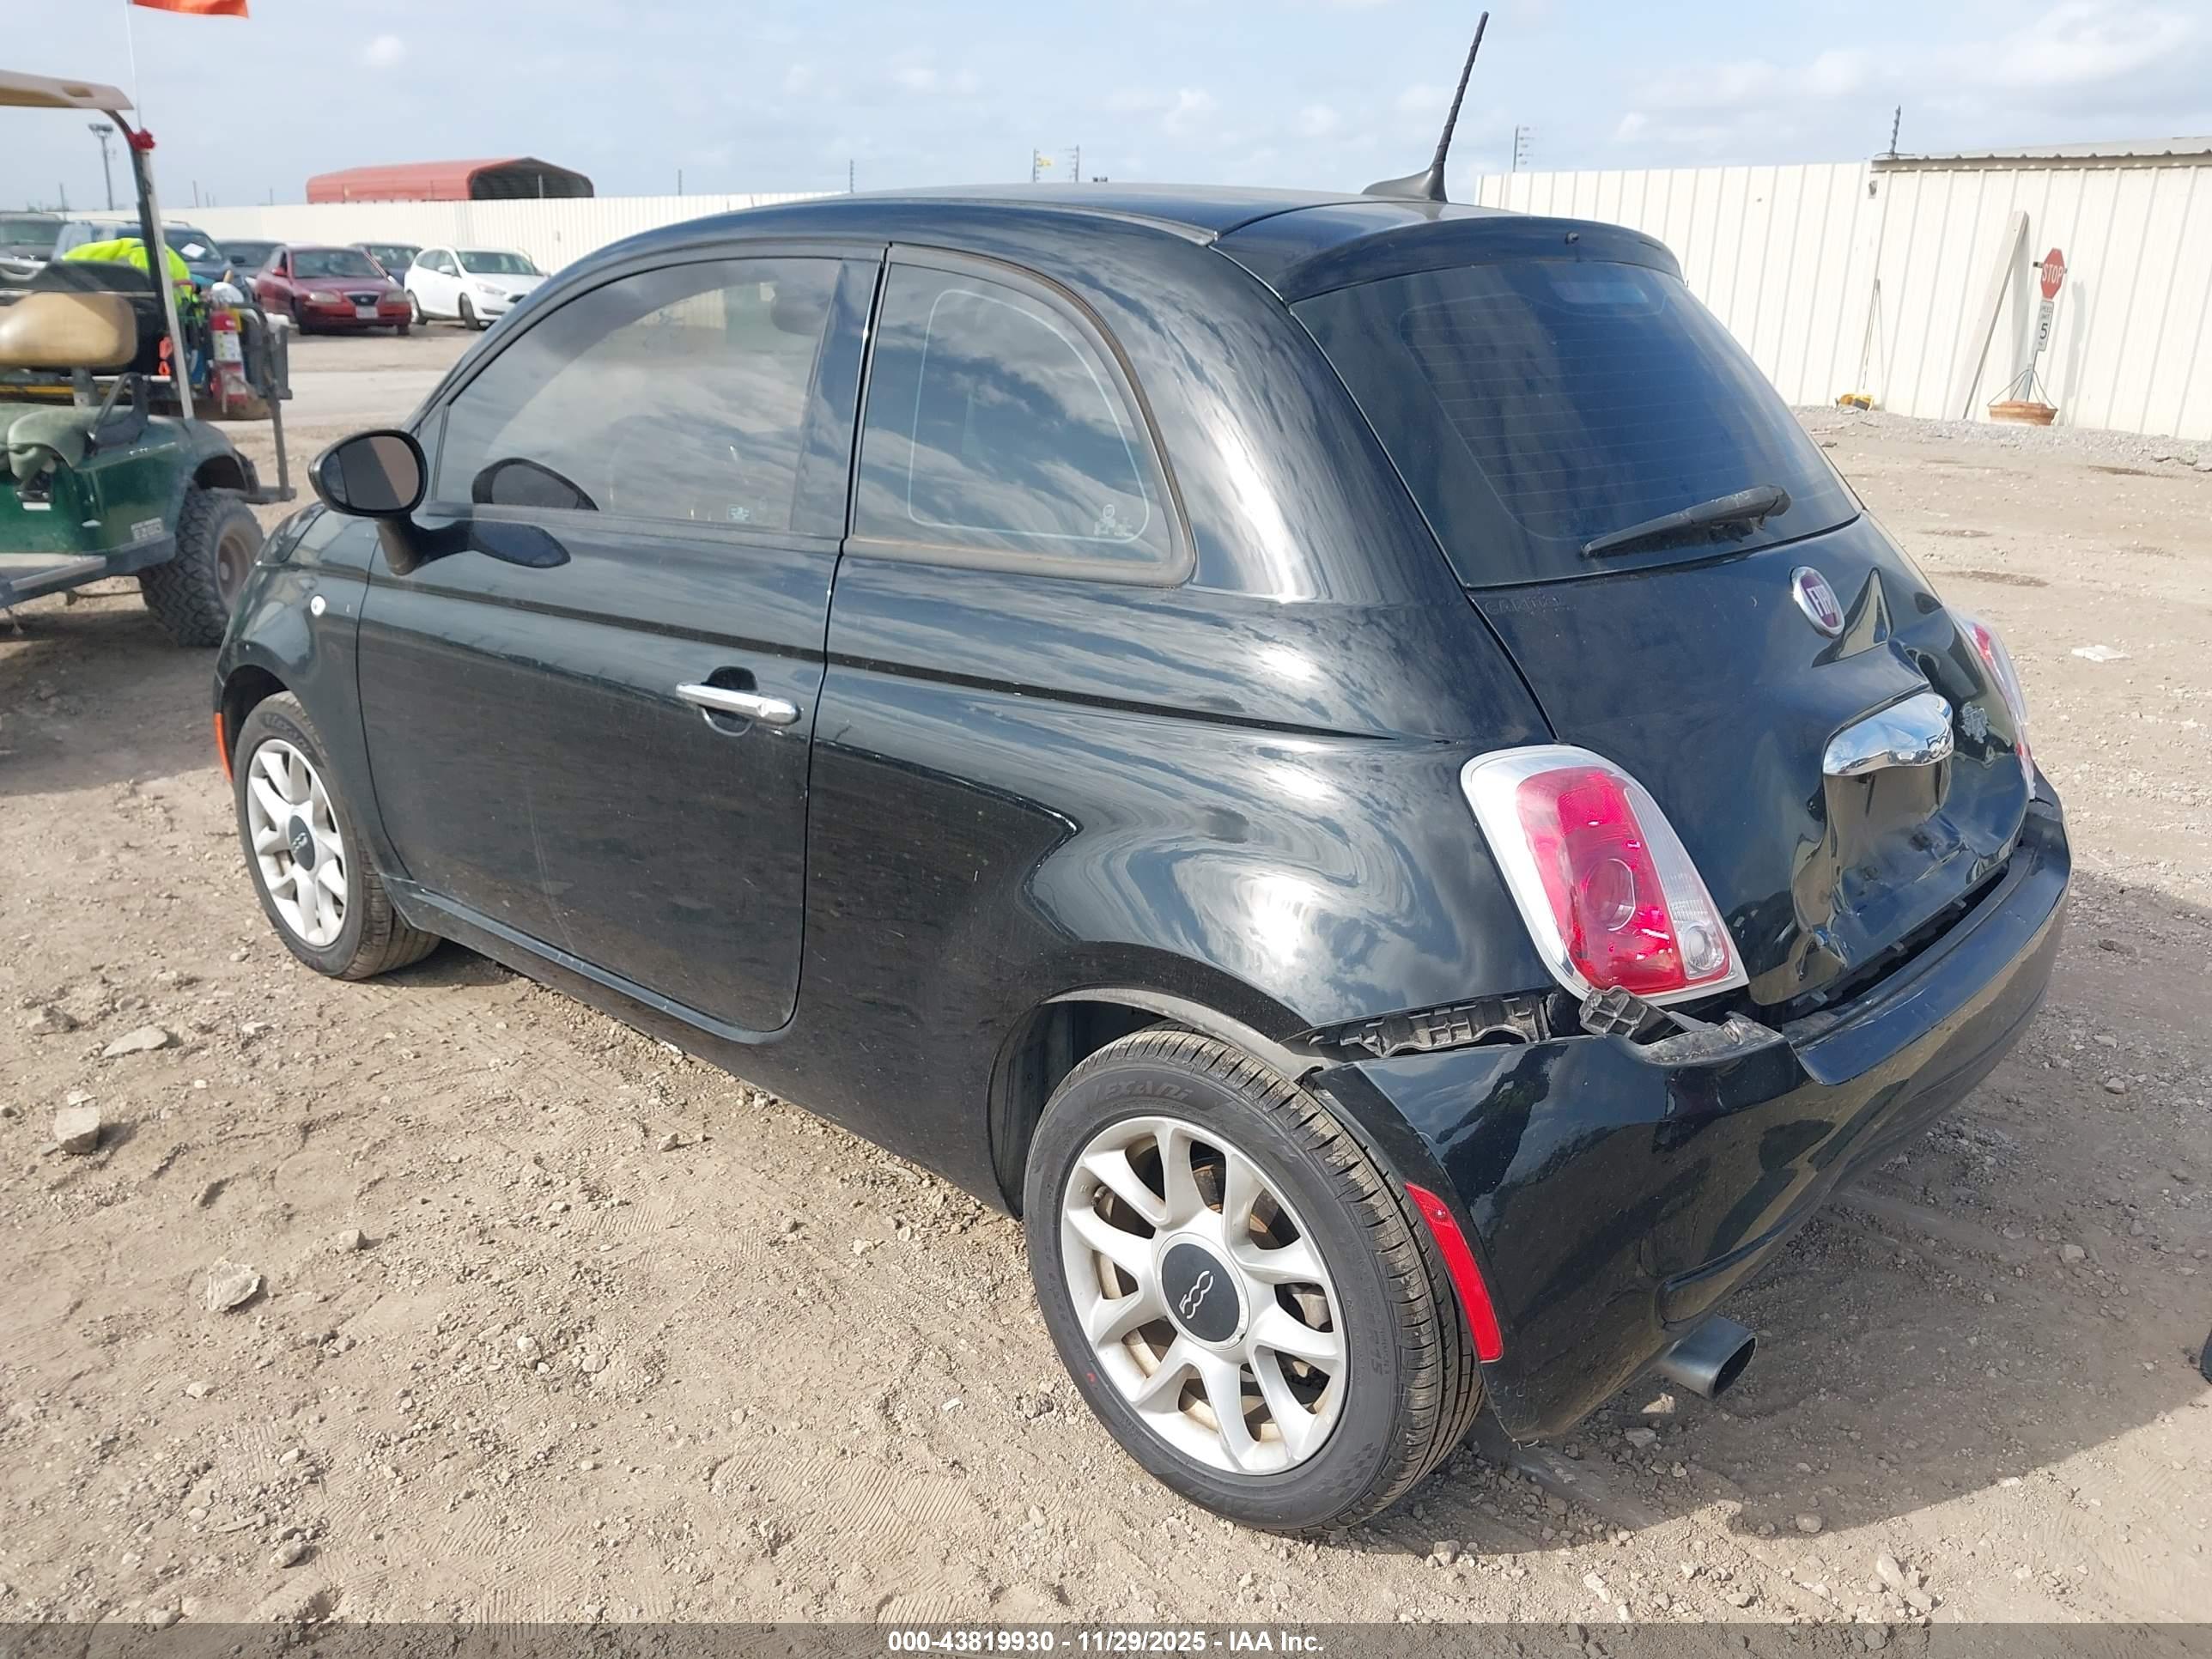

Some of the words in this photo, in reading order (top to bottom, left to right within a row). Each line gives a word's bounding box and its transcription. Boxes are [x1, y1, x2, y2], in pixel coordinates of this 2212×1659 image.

[2043, 264, 2063, 283] STOP
[2039, 322, 2049, 340] 5
[1178, 1270, 1215, 1320] 500
